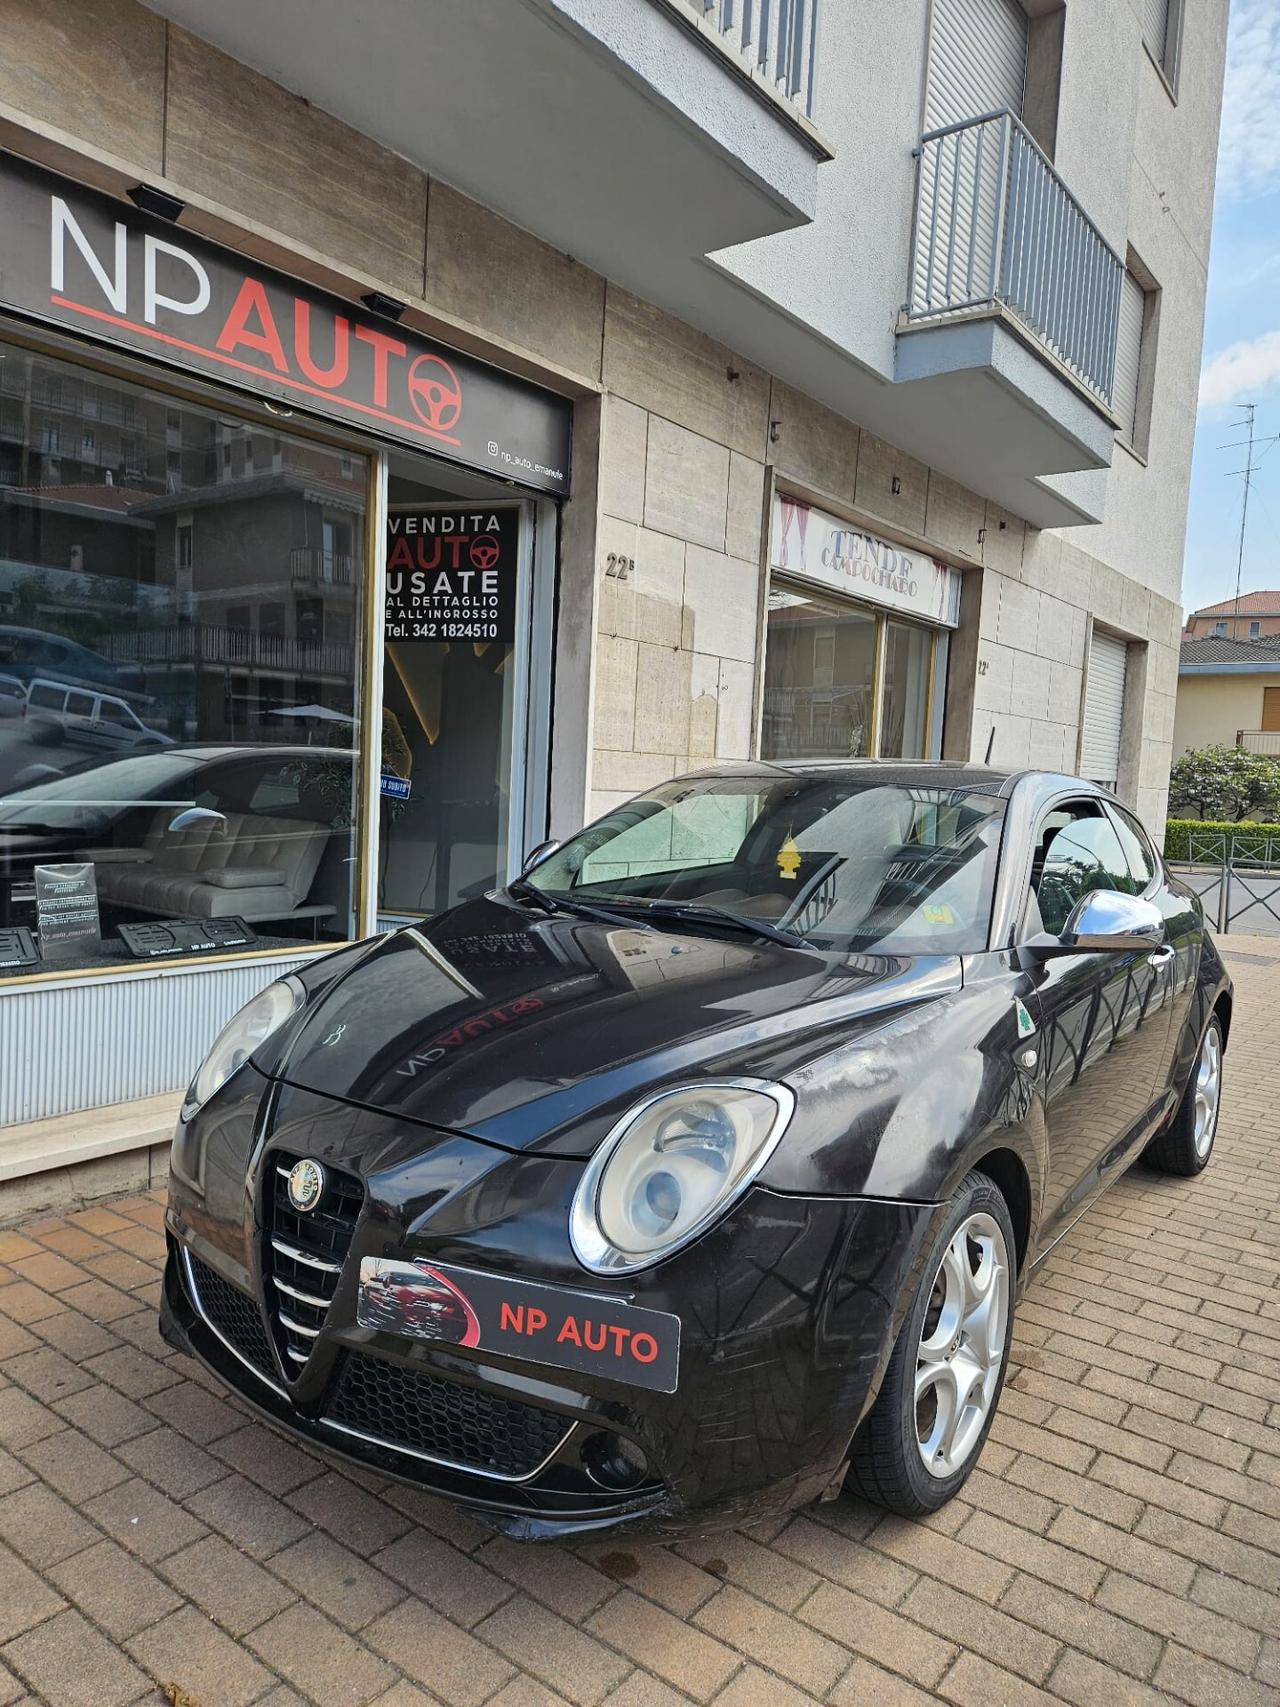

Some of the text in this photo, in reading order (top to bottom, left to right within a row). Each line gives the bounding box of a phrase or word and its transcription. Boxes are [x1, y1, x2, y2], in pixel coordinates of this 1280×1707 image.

[51, 196, 211, 324] NP
[388, 515, 500, 534] VENDITA
[831, 531, 912, 577] TENDE
[386, 571, 499, 594] USATE
[386, 596, 499, 607] AL DETTAGLIO
[385, 609, 498, 619] E ALL'INGROSSO
[386, 623, 497, 638] Tel. 342 1824510
[500, 1301, 659, 1363] NP AUTO
